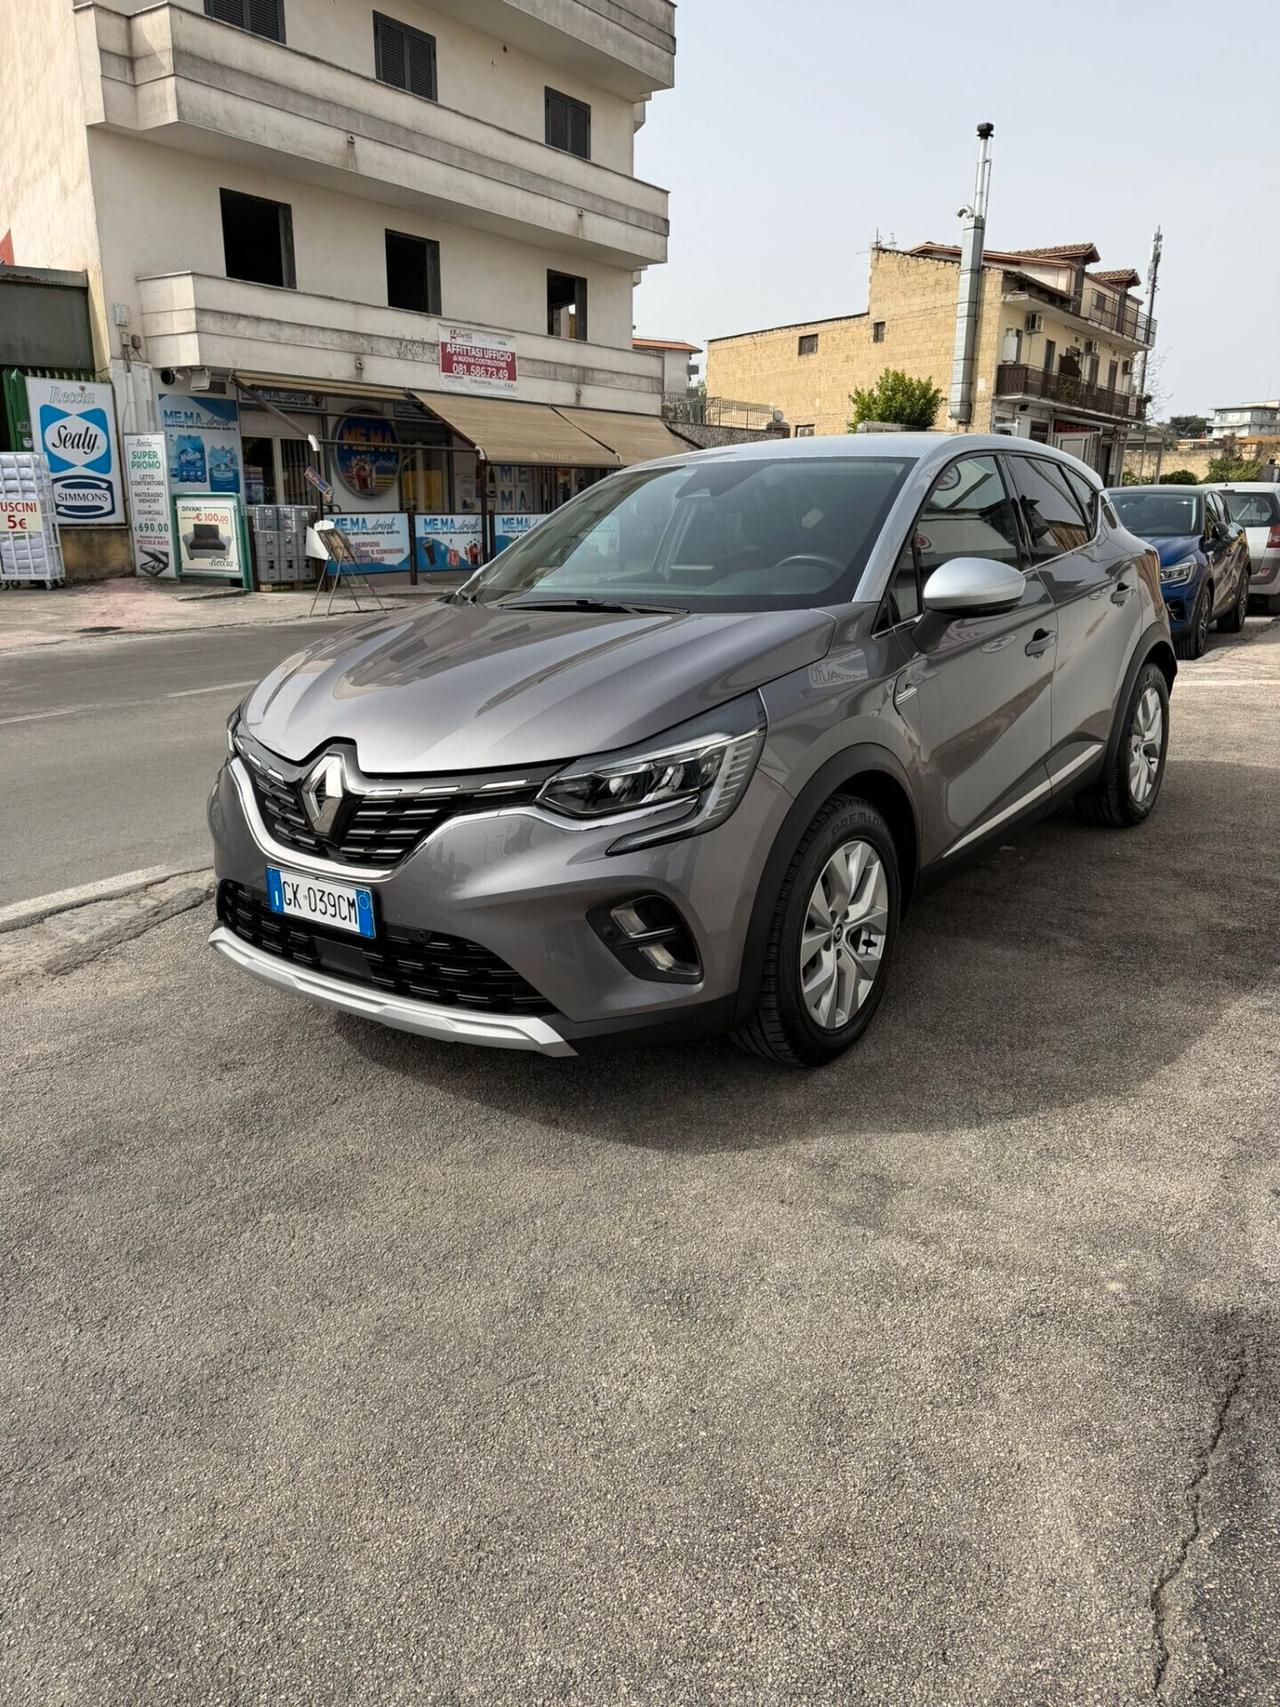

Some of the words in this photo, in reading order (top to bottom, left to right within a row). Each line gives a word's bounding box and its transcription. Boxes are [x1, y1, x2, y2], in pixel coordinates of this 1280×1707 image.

[446, 344, 483, 360] AFFITTASI
[484, 348, 512, 362] UFFICIO
[52, 424, 98, 455] Sealy
[132, 450, 158, 459] SUPER
[131, 460, 161, 470] PROMO
[58, 492, 108, 502] SIMMONS
[0, 502, 37, 513] USCINI
[371, 516, 396, 531] drink
[458, 518, 480, 530] drink
[282, 880, 302, 910] GK
[307, 886, 358, 925] 039CM
